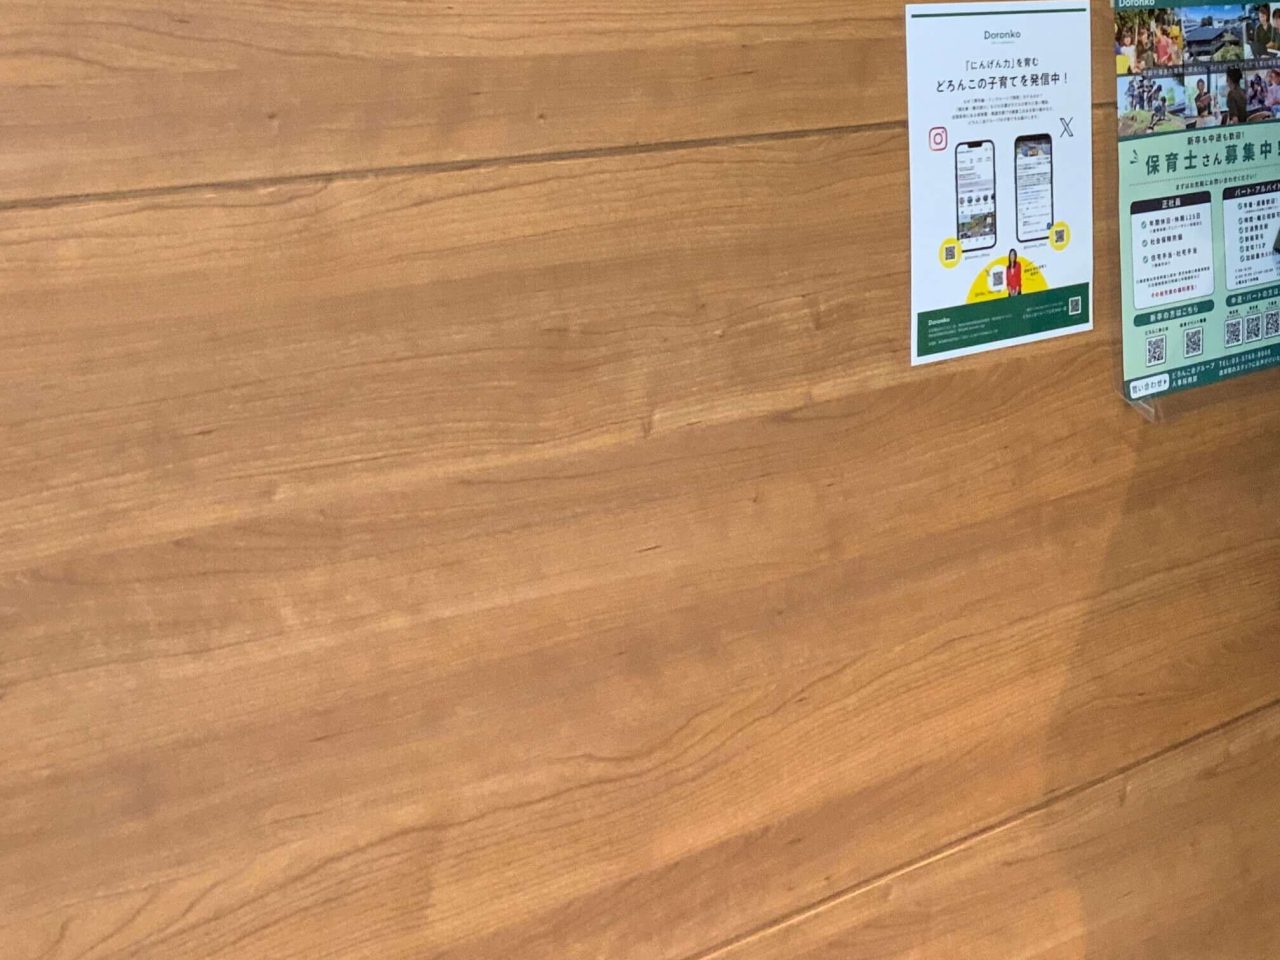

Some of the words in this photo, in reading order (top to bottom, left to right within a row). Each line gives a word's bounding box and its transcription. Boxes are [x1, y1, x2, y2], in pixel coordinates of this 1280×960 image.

[984, 30, 1021, 40] Doronko
[1161, 197, 1182, 209] 正社員
